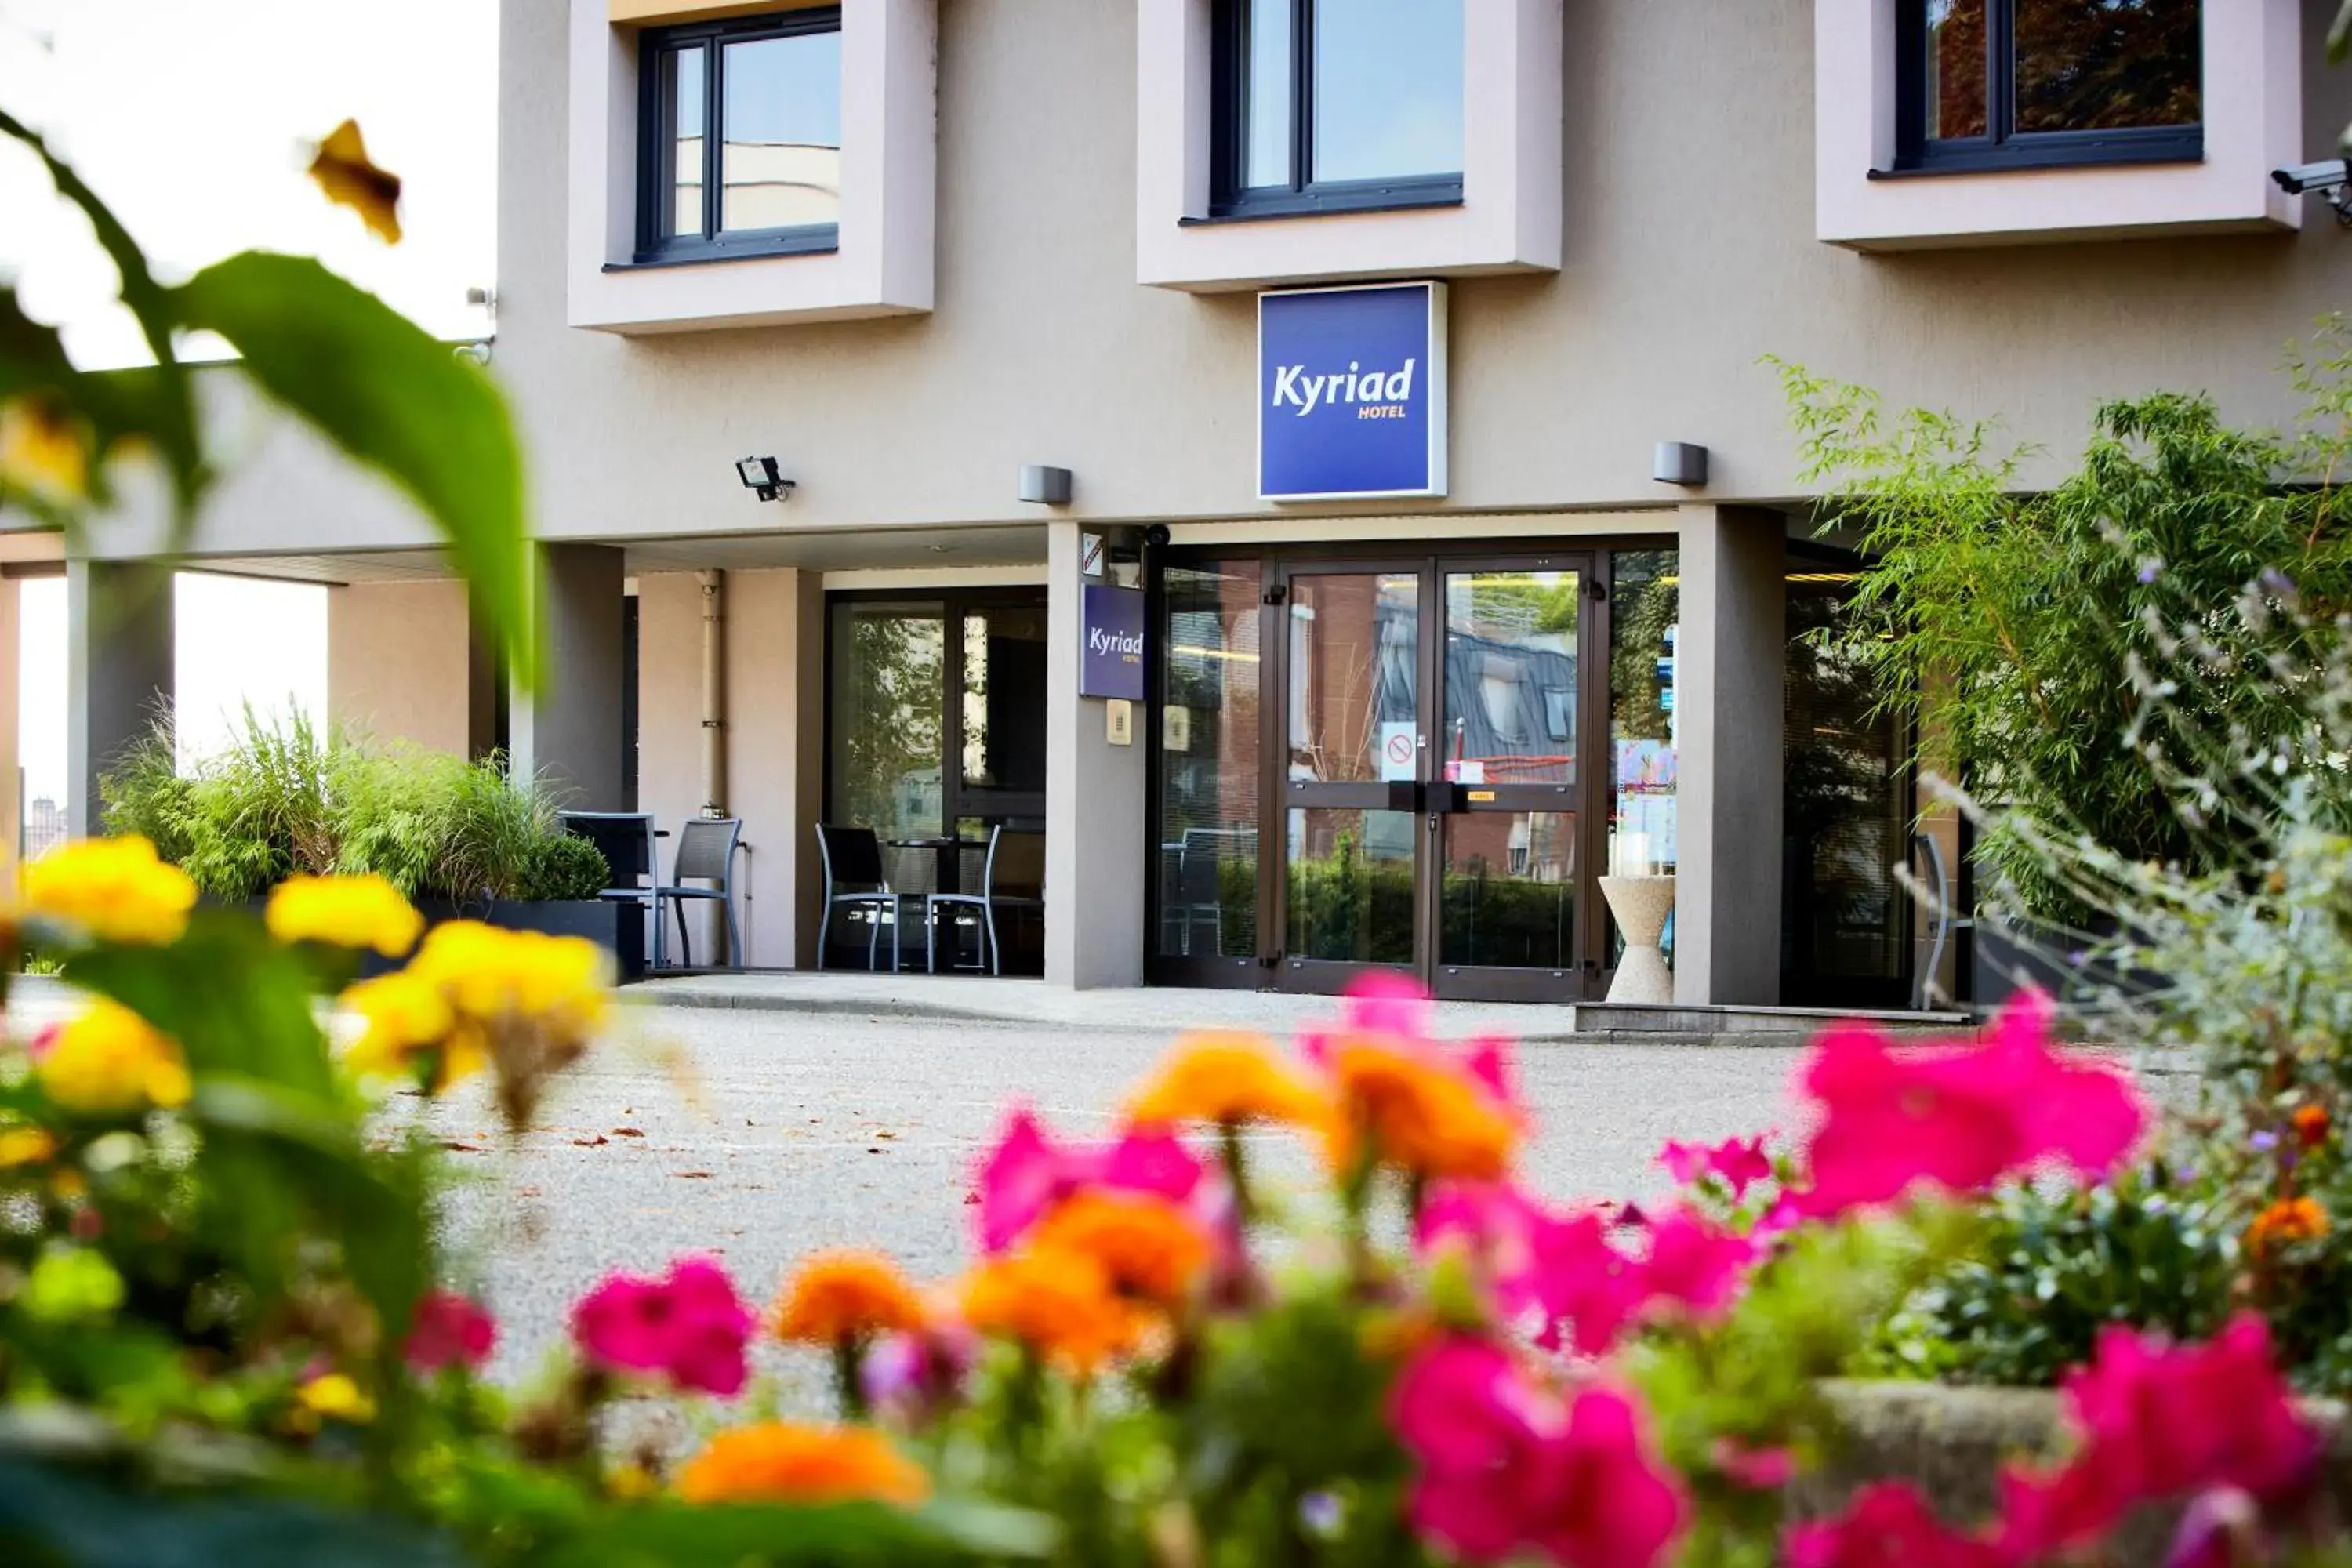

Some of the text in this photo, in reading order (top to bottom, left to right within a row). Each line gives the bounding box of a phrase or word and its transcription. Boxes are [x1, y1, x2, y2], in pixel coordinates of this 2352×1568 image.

[1273, 358, 1416, 416] Kyriad
[1358, 406, 1406, 419] HOTEL
[1090, 627, 1144, 656] Kyriad
